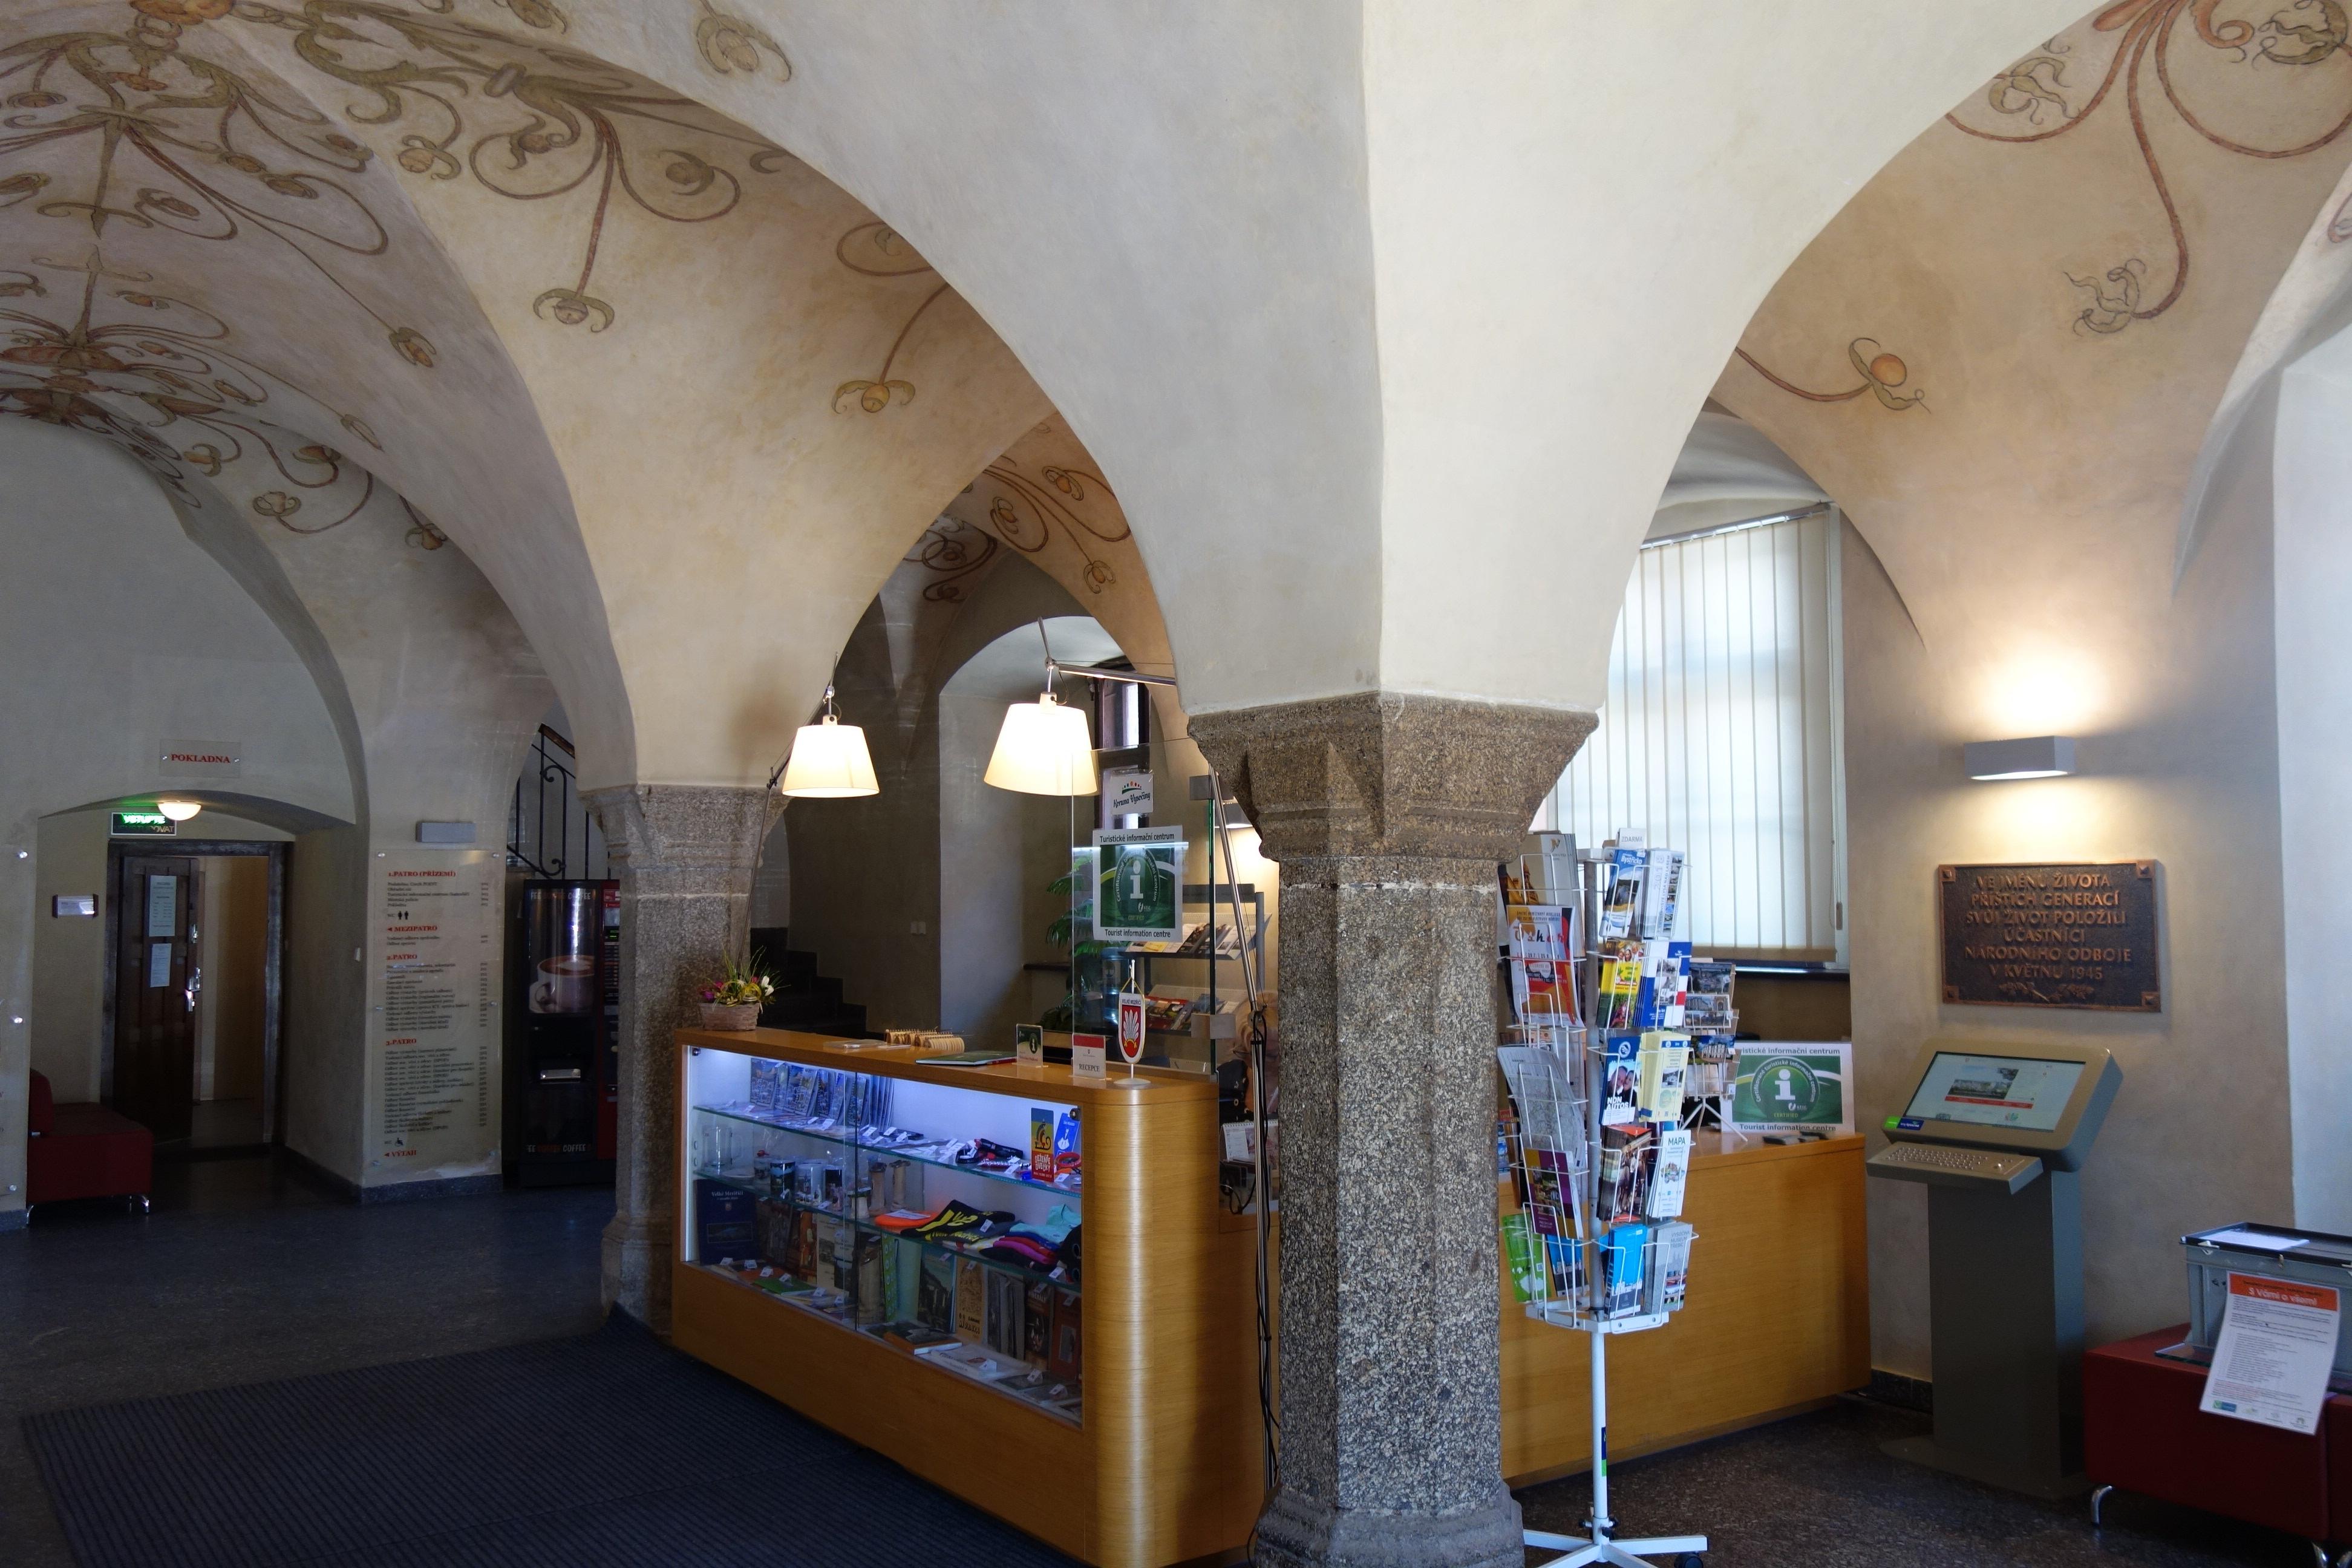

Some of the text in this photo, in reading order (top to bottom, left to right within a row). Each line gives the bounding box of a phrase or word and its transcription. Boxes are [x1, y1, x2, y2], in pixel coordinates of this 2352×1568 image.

[171, 754, 230, 763] POKLADNA
[1113, 791, 1151, 808] Koruna Vysočiny
[1100, 834, 1125, 843] Turistické
[1126, 832, 1152, 841] informační
[1976, 875, 1996, 887] VE
[2053, 872, 2111, 888] ŽIVOTA
[2042, 890, 2120, 906] GENERACÍ
[2003, 909, 2048, 925] ŽIVOT
[2053, 909, 2126, 925] POLOŽILI
[1105, 929, 1123, 937] Tourist
[1123, 929, 1152, 938] information
[2067, 947, 2132, 962] ODBOJE
[1988, 963, 2104, 980] V KVĚTNU 1945
[1079, 1063, 1100, 1072] RECEPCE
[1668, 1137, 1686, 1146] MAPA
[563, 1143, 586, 1152] COFFEE
[2248, 1287, 2255, 1296] S
